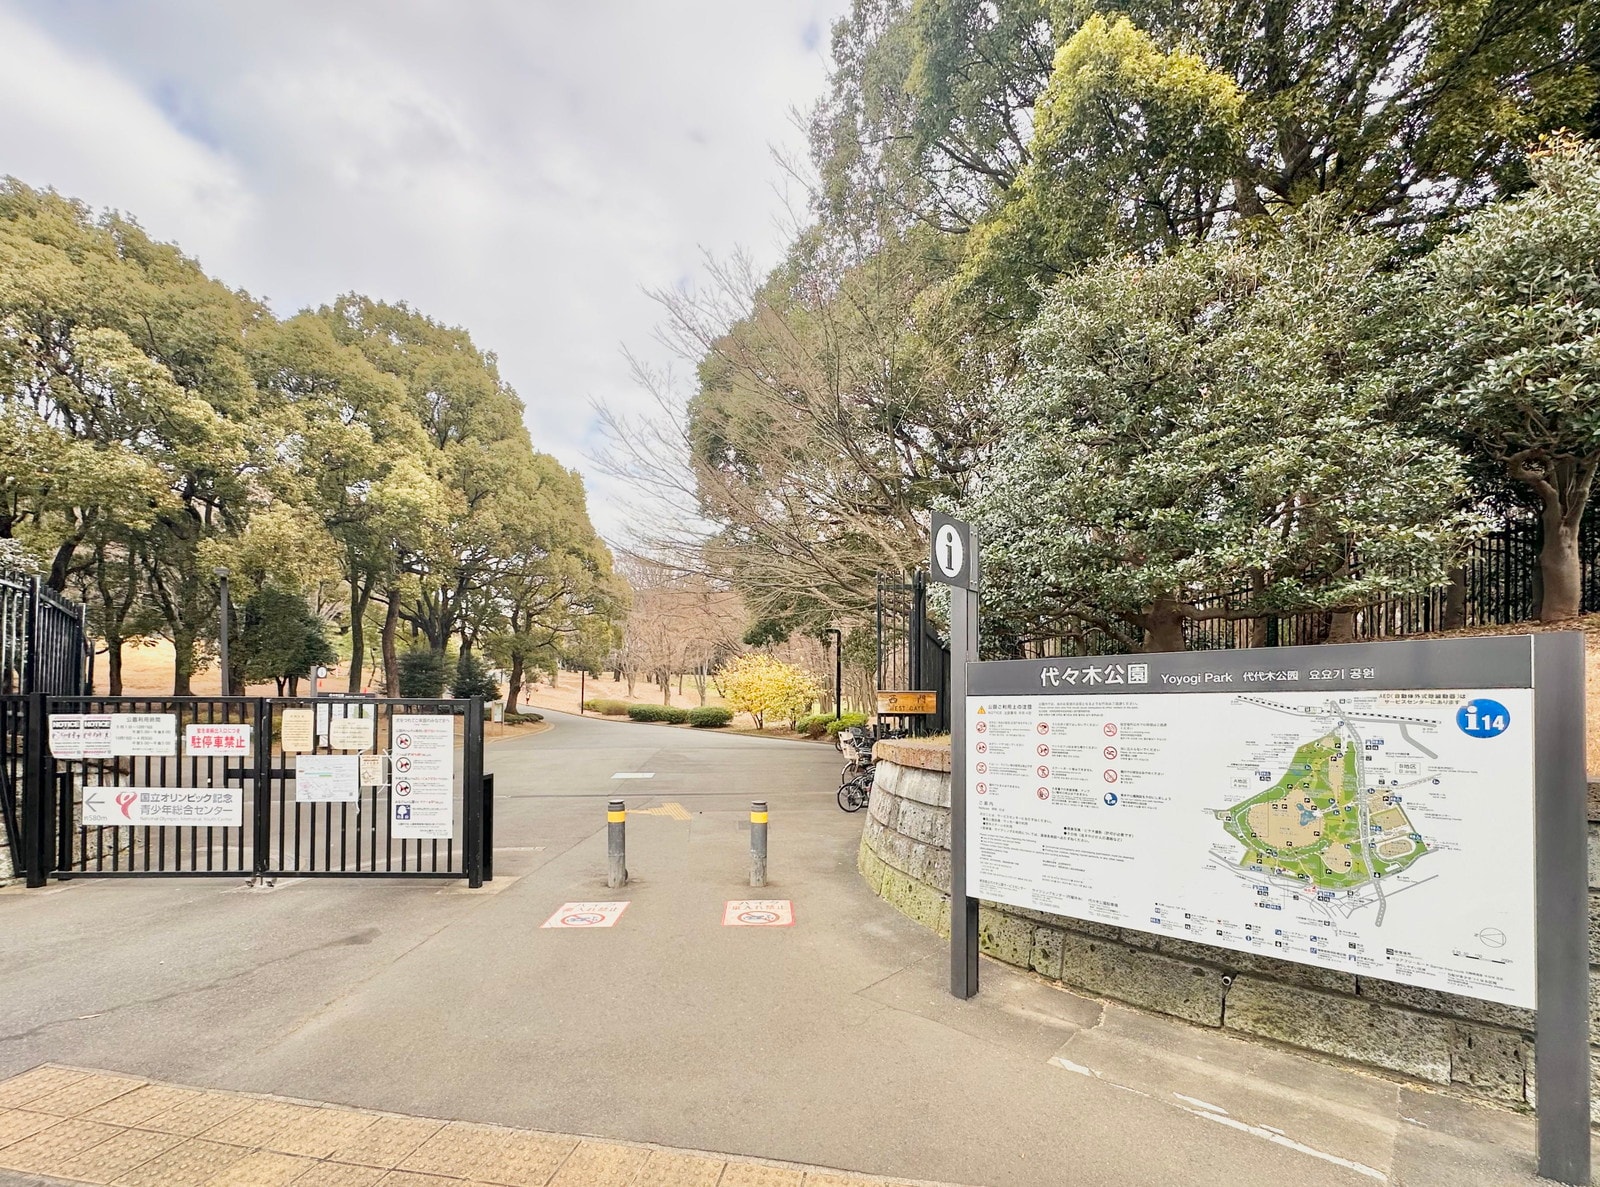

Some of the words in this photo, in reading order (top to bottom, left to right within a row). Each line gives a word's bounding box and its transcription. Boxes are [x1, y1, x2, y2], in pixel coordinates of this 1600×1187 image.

[1040, 663, 1148, 687] 代々木公園
[1161, 673, 1201, 685] Yoyogi
[1205, 672, 1232, 683] Park
[1243, 669, 1299, 682] 代代木公园
[1309, 668, 1344, 680] 요요기
[1350, 667, 1375, 680] 공원
[191, 735, 246, 749] 駐停車禁止
[140, 793, 233, 803] 国立オリンピック記念
[140, 805, 233, 816] 青少年総合センター
